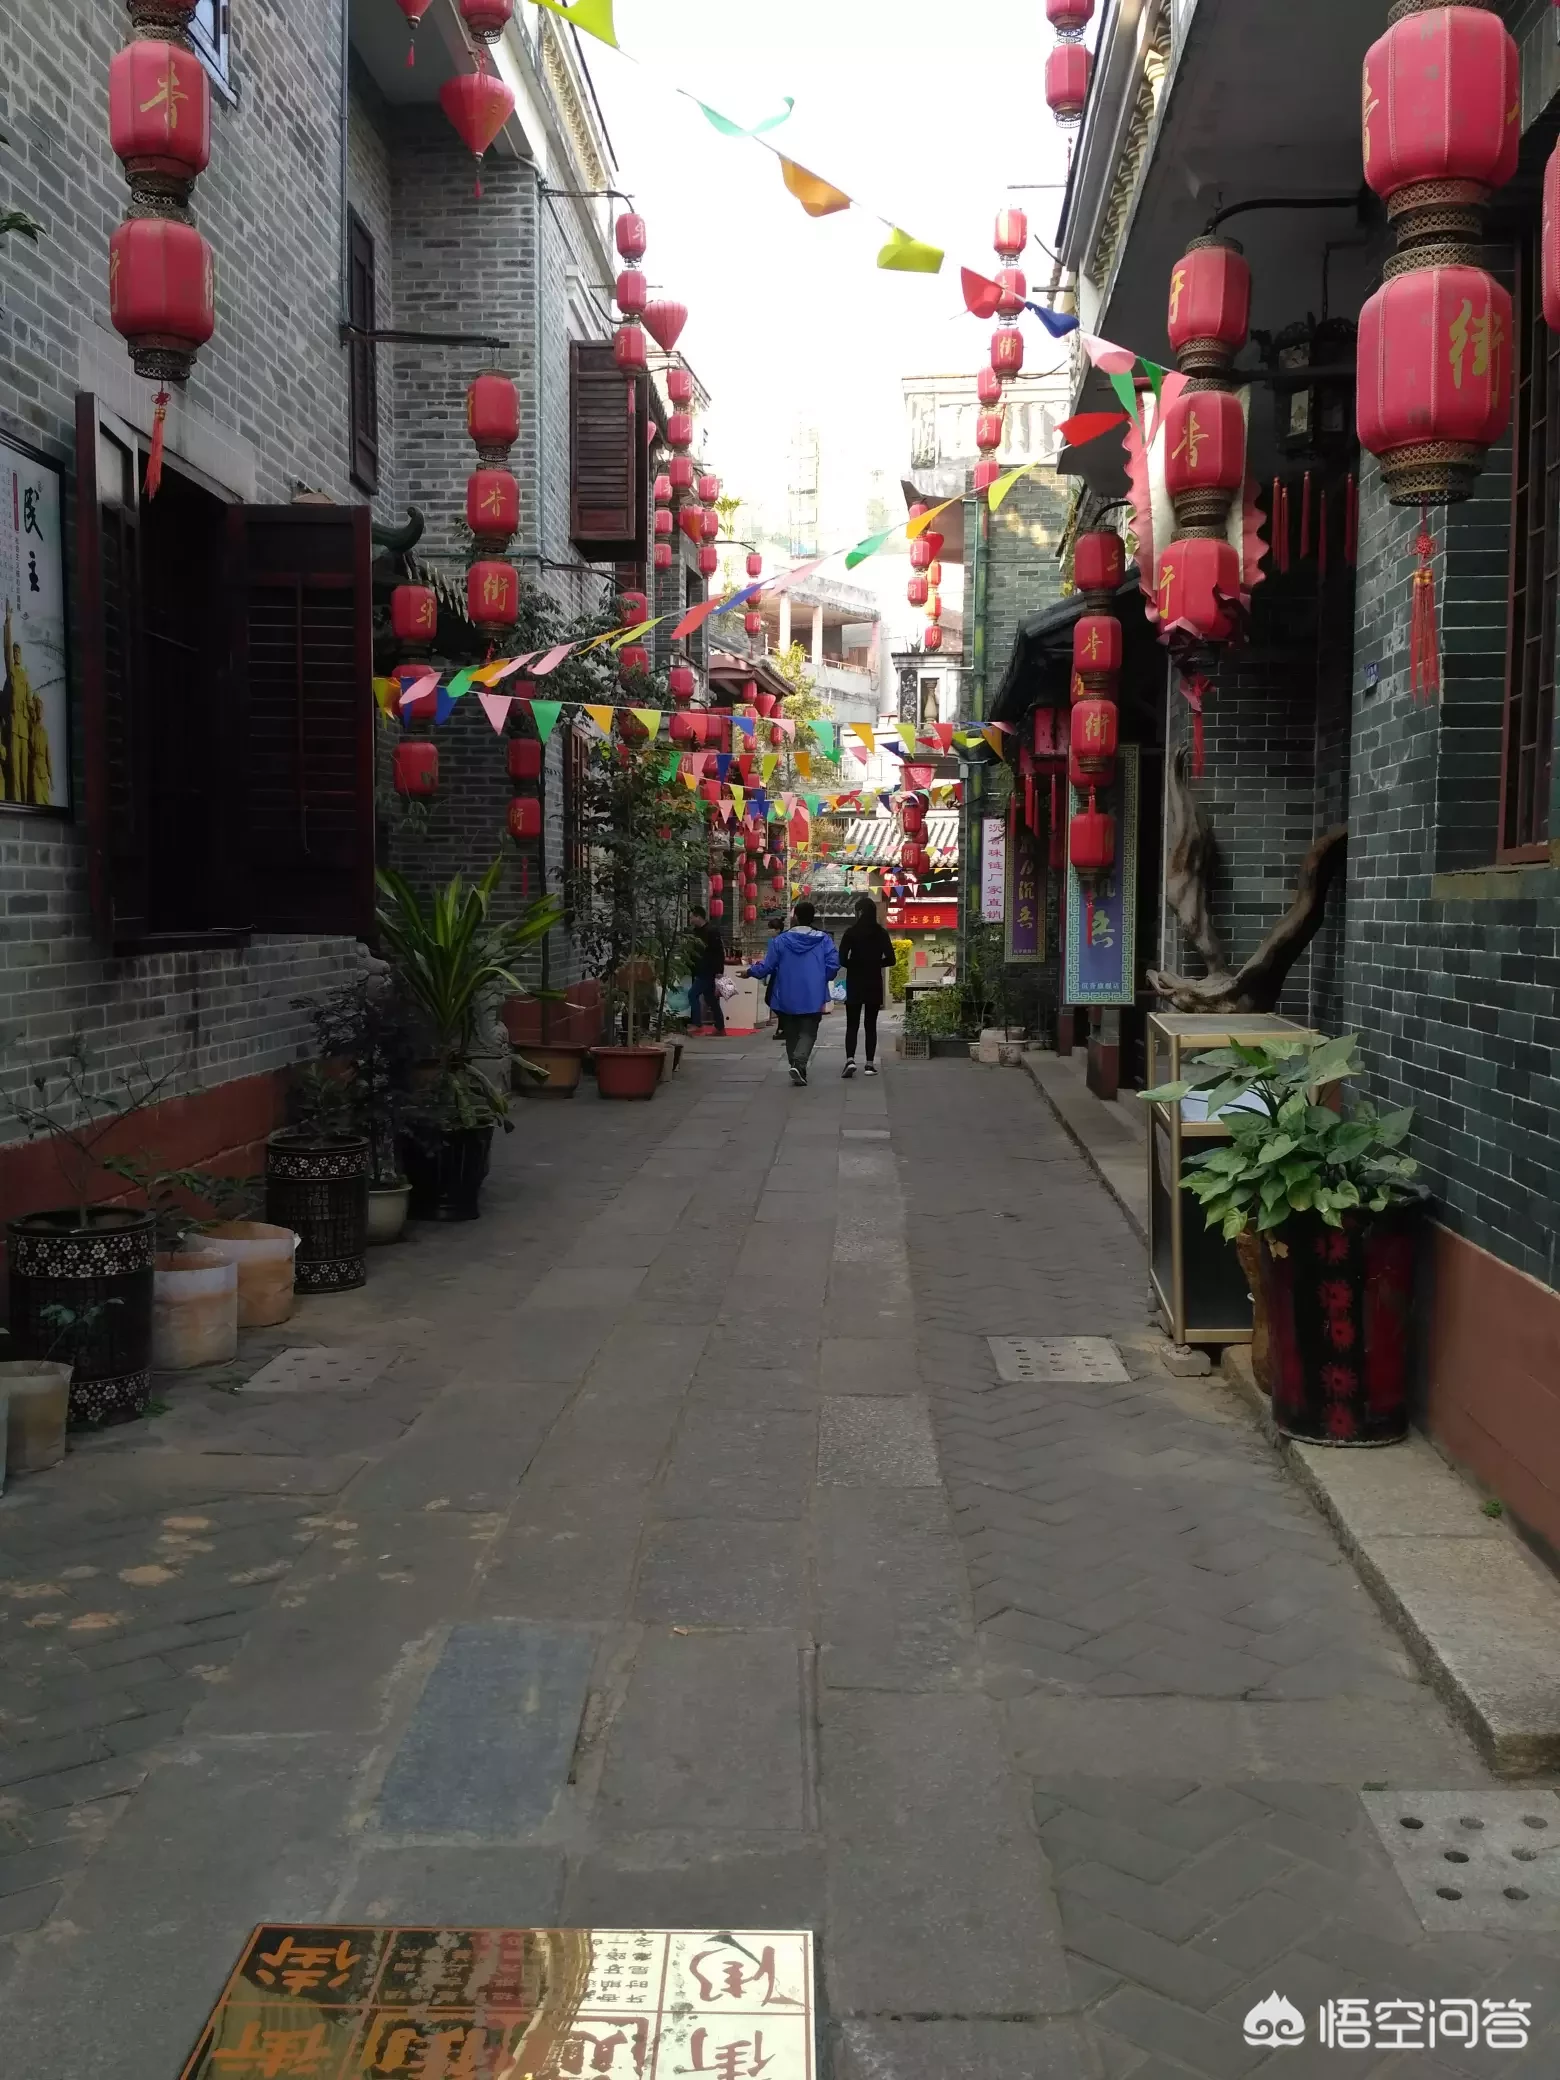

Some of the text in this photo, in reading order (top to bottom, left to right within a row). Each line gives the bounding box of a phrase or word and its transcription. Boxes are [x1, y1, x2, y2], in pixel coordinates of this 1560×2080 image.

[1000, 336, 1018, 361] 街
[1449, 298, 1504, 408] 街
[1172, 411, 1209, 467] 香
[481, 481, 507, 517] 香
[483, 572, 510, 612] 街
[1081, 627, 1103, 660] 香
[1085, 712, 1109, 745] 街
